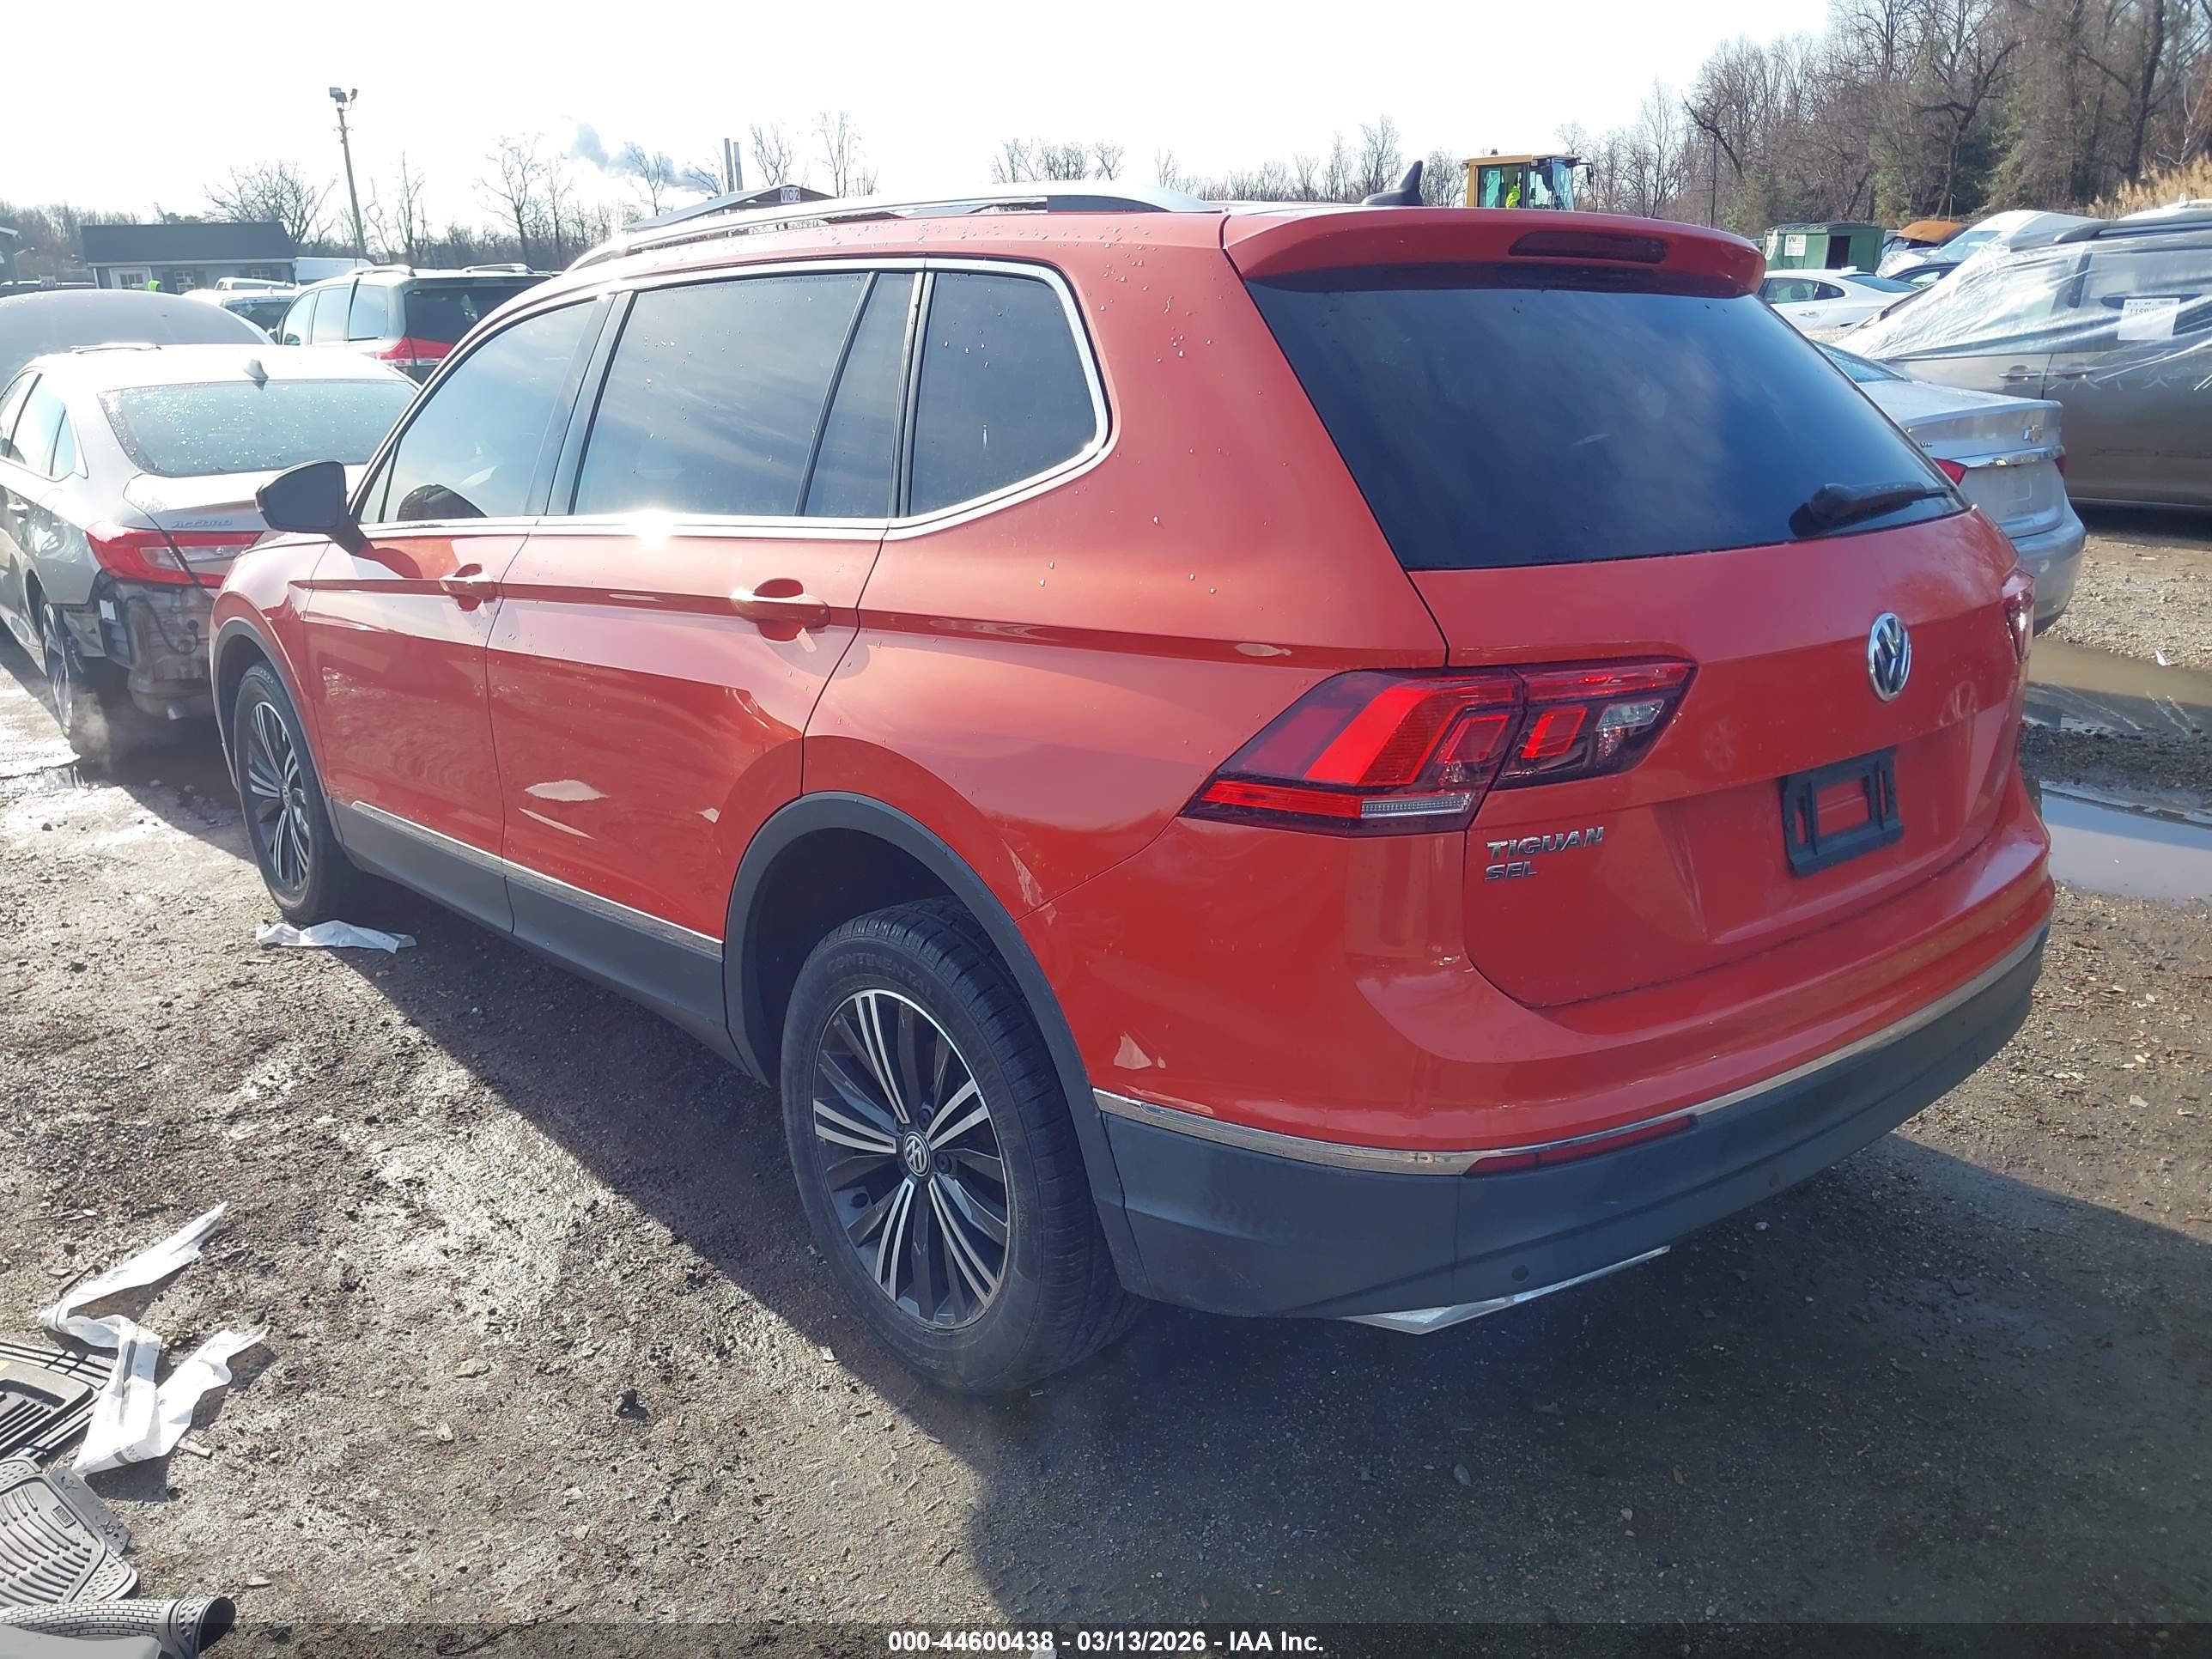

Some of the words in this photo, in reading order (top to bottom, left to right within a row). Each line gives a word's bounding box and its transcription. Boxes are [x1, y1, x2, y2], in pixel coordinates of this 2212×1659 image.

[781, 189, 793, 201] VIC
[795, 189, 799, 201] 2
[1486, 826, 1604, 860] TIGUAN
[1485, 860, 1538, 882] SEL
[826, 952, 934, 1001] CONTINENTAL
